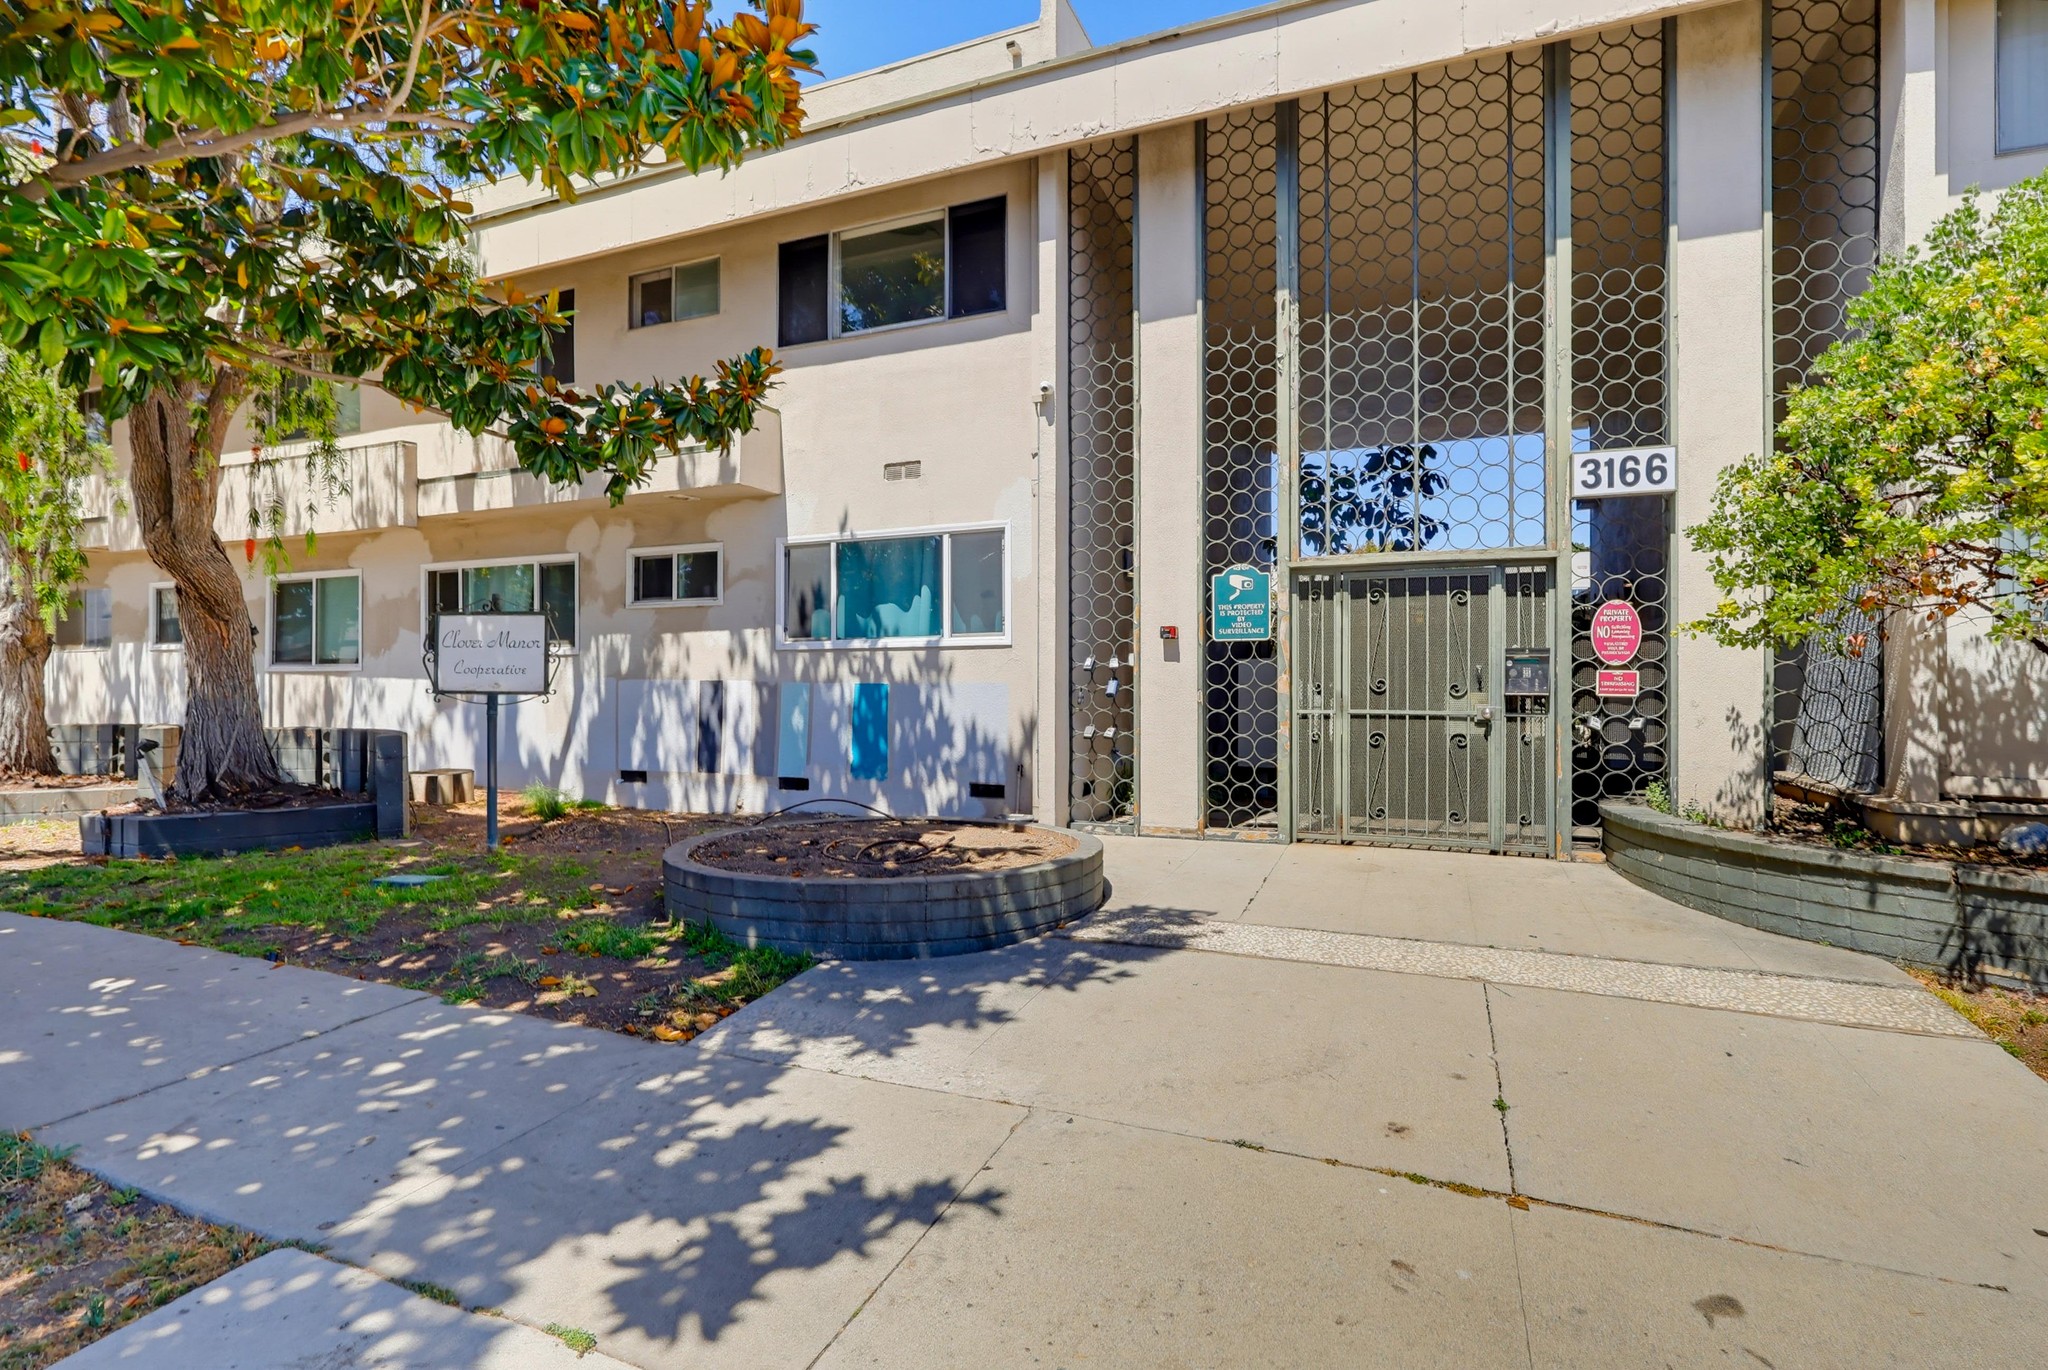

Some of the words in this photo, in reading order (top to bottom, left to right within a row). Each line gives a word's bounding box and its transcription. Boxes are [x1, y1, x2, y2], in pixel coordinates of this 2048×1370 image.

[1580, 452, 1668, 490] 3166
[442, 629, 483, 648] Clover
[487, 630, 541, 649] Manor
[1596, 625, 1610, 638] NO
[453, 659, 527, 679] Cooperative
